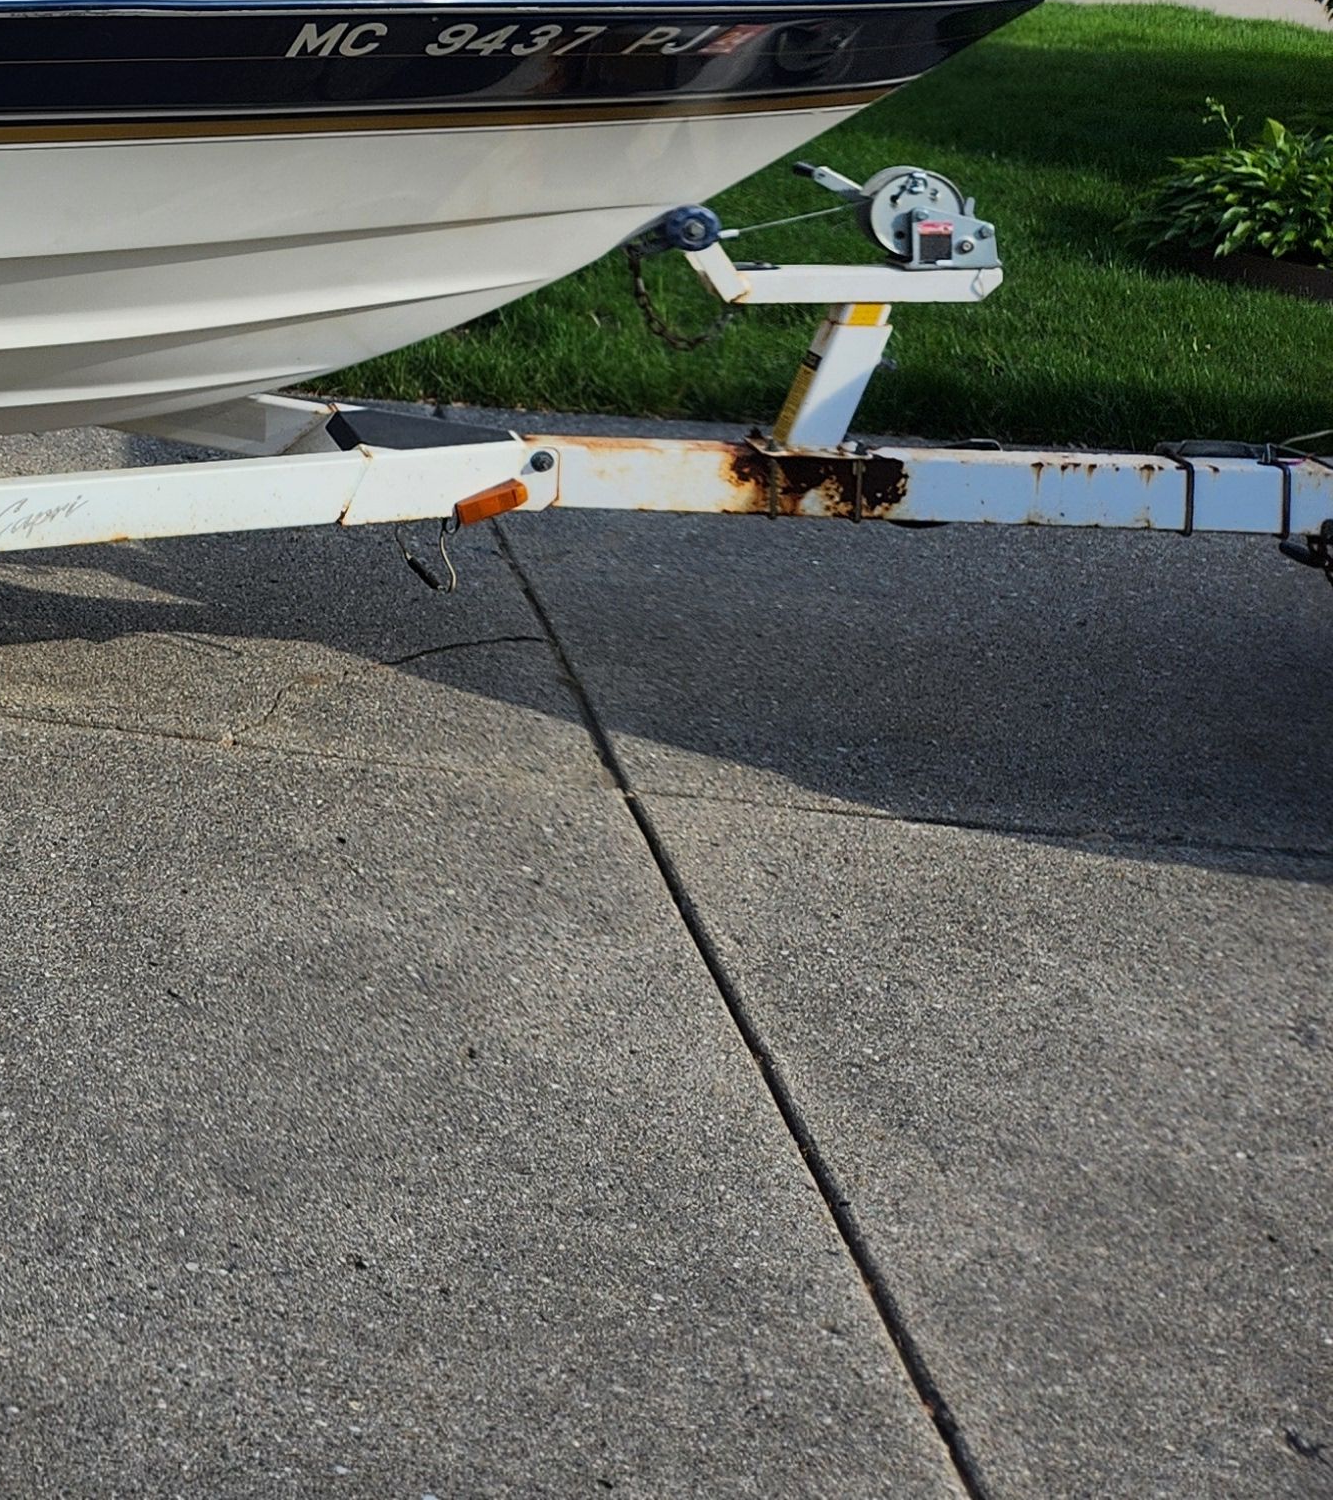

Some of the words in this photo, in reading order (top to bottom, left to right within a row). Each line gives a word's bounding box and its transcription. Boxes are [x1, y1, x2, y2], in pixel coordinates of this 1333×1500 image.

[285, 22, 388, 57] MC
[425, 22, 607, 56] 9437
[621, 24, 720, 55] PJ
